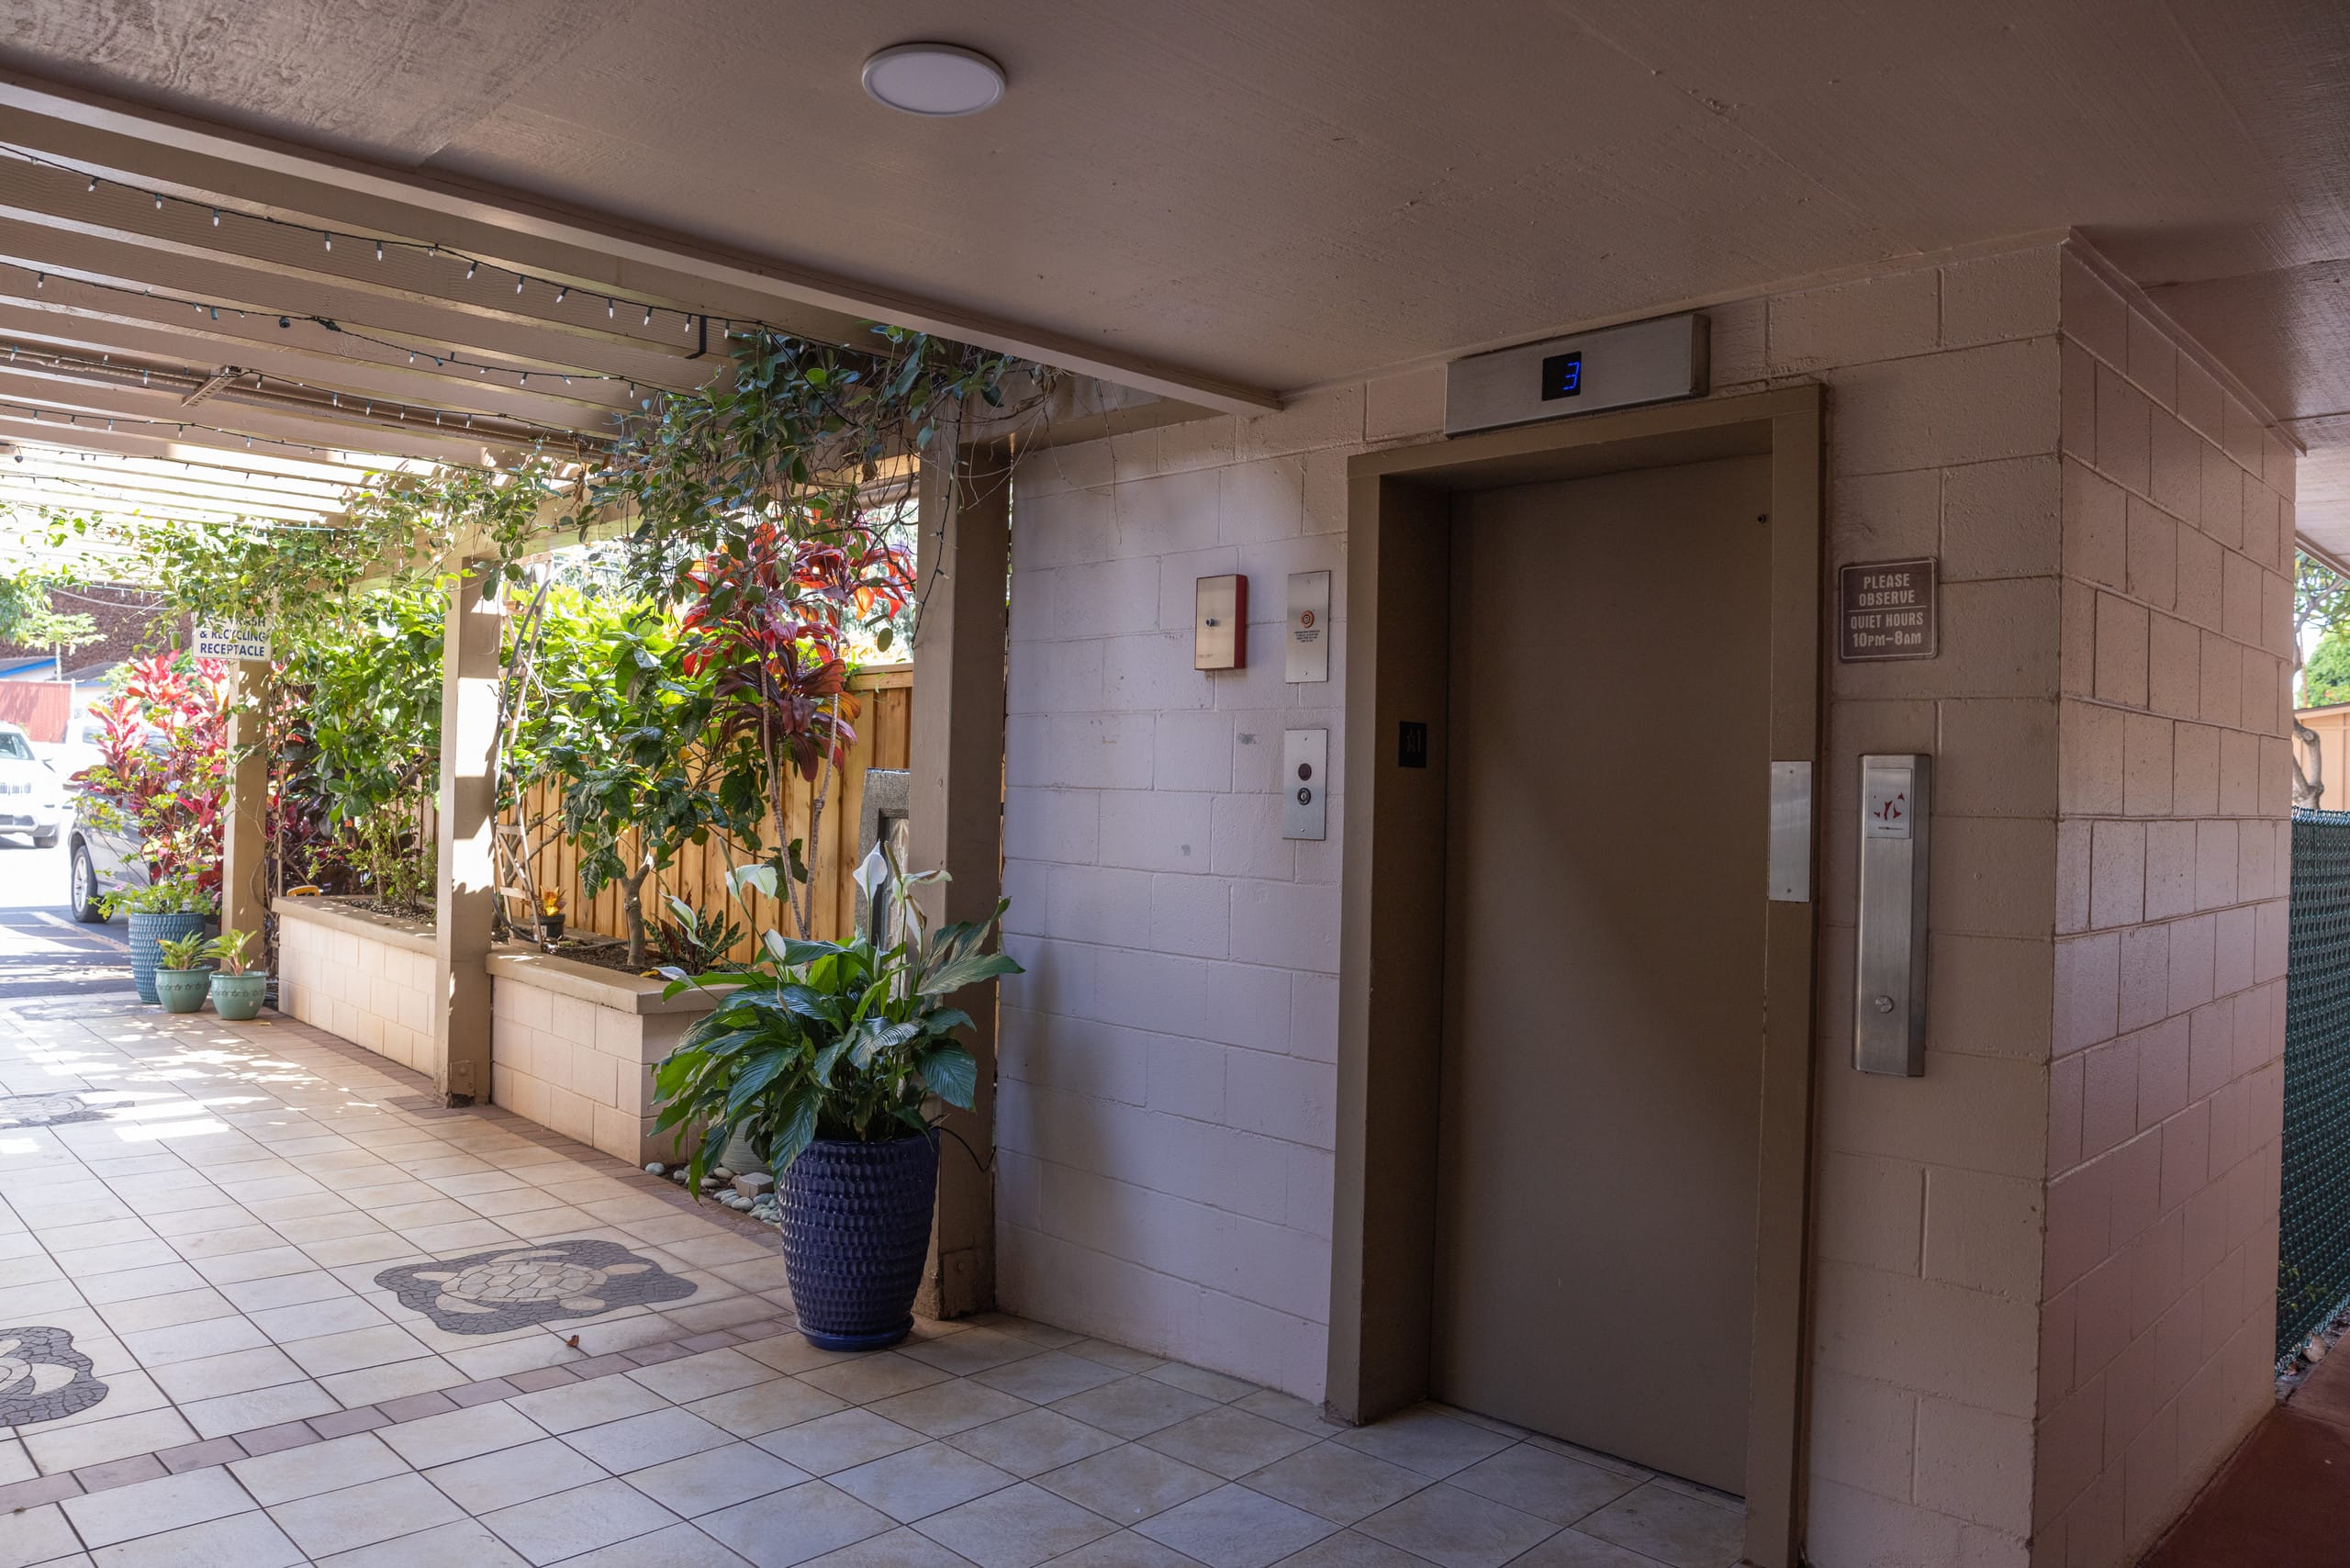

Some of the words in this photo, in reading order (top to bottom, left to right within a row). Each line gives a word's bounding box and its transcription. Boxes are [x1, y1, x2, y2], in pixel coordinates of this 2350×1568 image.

[1563, 362, 1580, 390] 3
[1863, 574, 1910, 589] PLEASE
[1859, 590, 1915, 606] OBSERVE
[1851, 615, 1882, 629] QUIET
[1886, 612, 1924, 626] HOURS
[199, 630, 207, 639] &
[200, 643, 265, 656] RECEPTACLE
